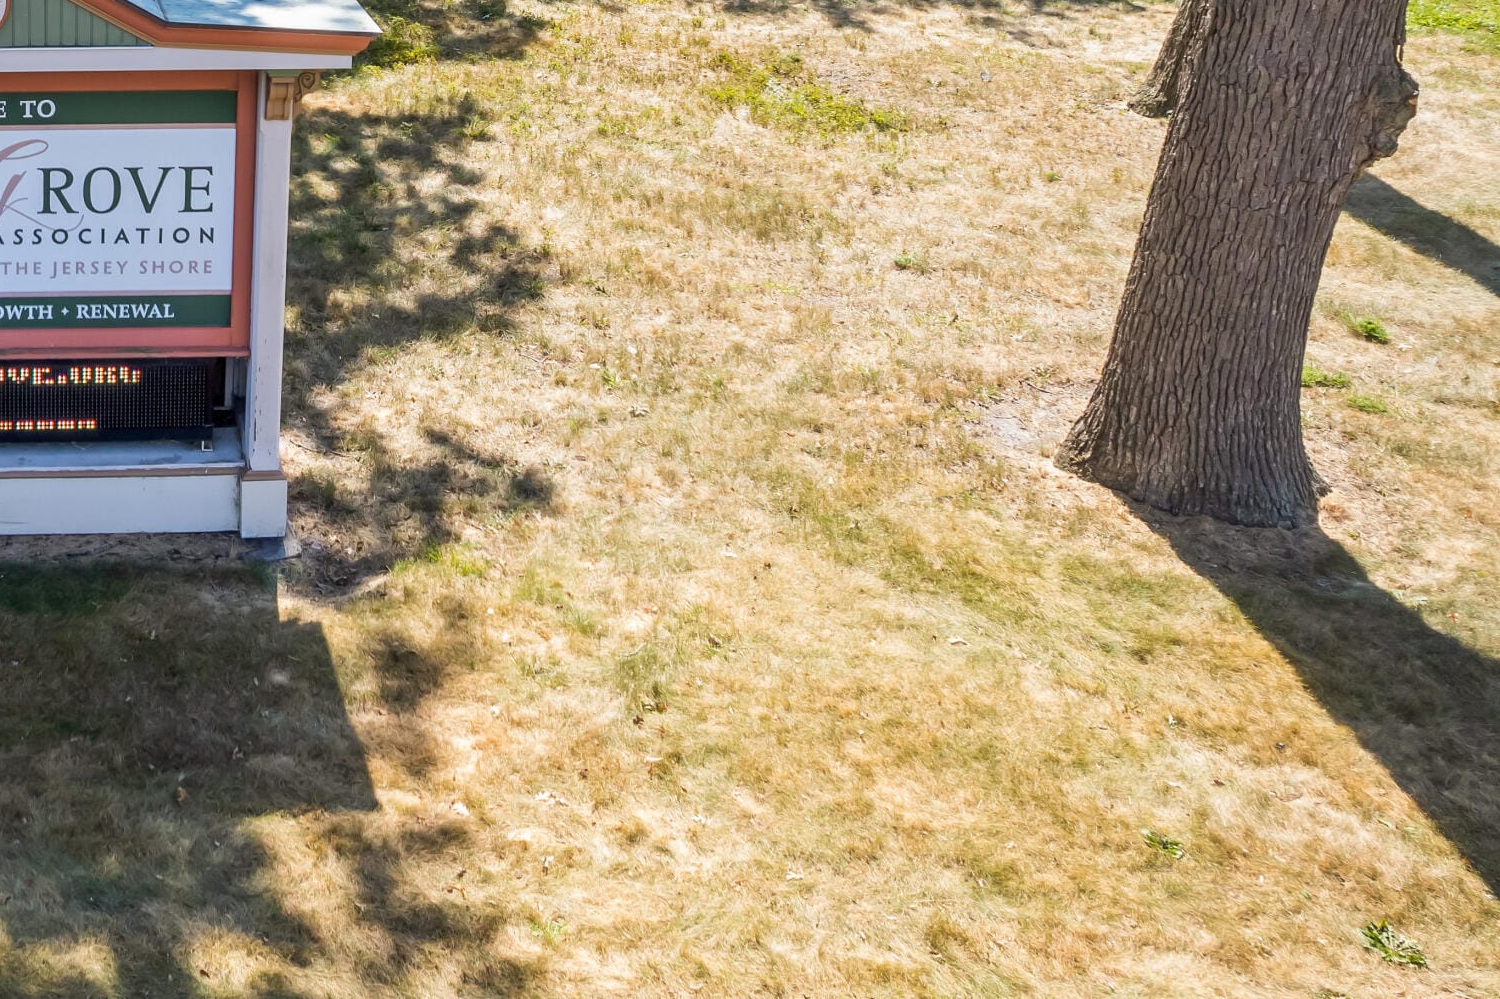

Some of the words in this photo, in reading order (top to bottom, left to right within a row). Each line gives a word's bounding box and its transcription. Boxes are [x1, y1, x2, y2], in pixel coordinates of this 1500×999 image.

[19, 99, 56, 119] TO
[0, 261, 42, 276] THE
[49, 260, 129, 280] JERSEY
[138, 259, 213, 275] SHORE
[75, 303, 175, 320] RENEWAL
